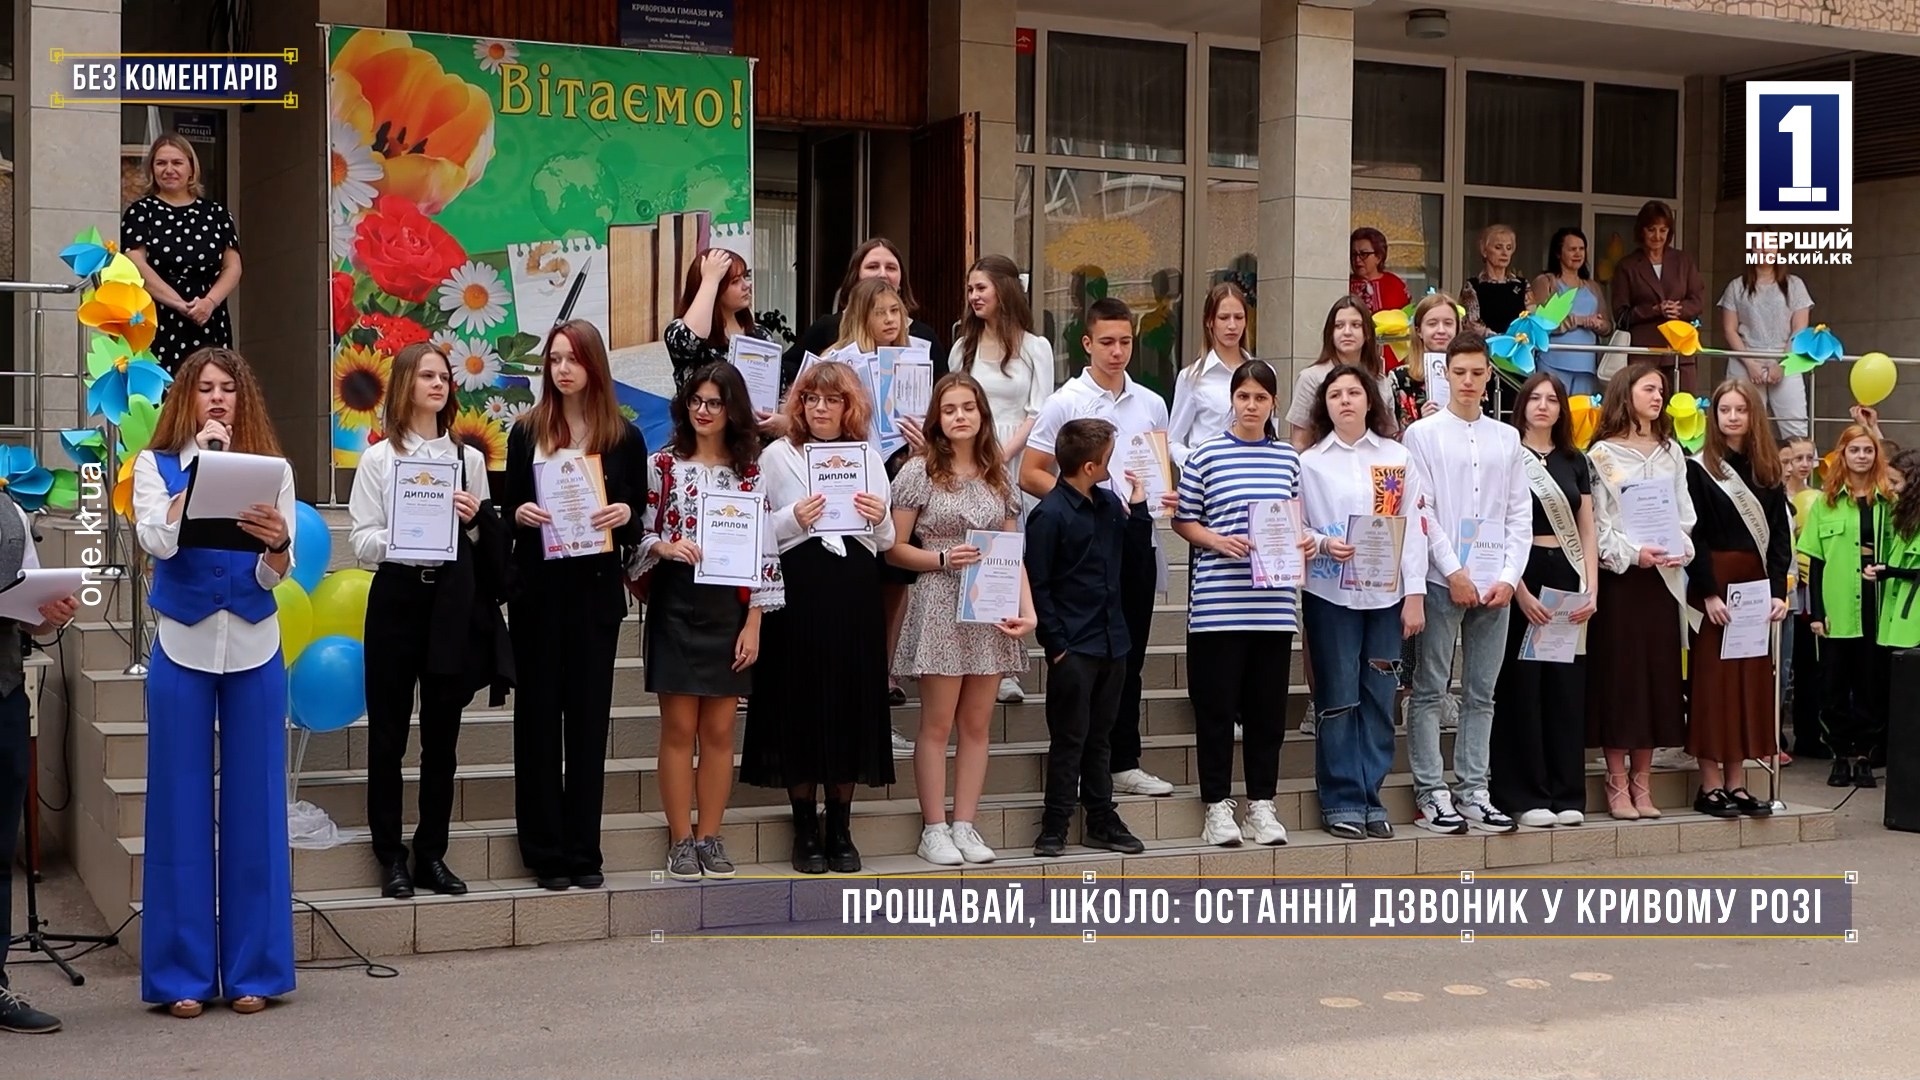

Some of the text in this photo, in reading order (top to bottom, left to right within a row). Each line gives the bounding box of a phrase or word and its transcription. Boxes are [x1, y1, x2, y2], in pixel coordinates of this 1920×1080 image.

[631, 3, 676, 15] КРИВОРІЗЬКА
[677, 7, 708, 17] ГІМНАЗІЯ
[499, 62, 743, 129] Вітаємо!
[817, 472, 857, 481] ДИПЛОМ
[403, 490, 445, 499] ДИПЛОМ
[710, 520, 748, 529] ДИПЛОМ
[983, 557, 1020, 567] ДИПЛОМ
